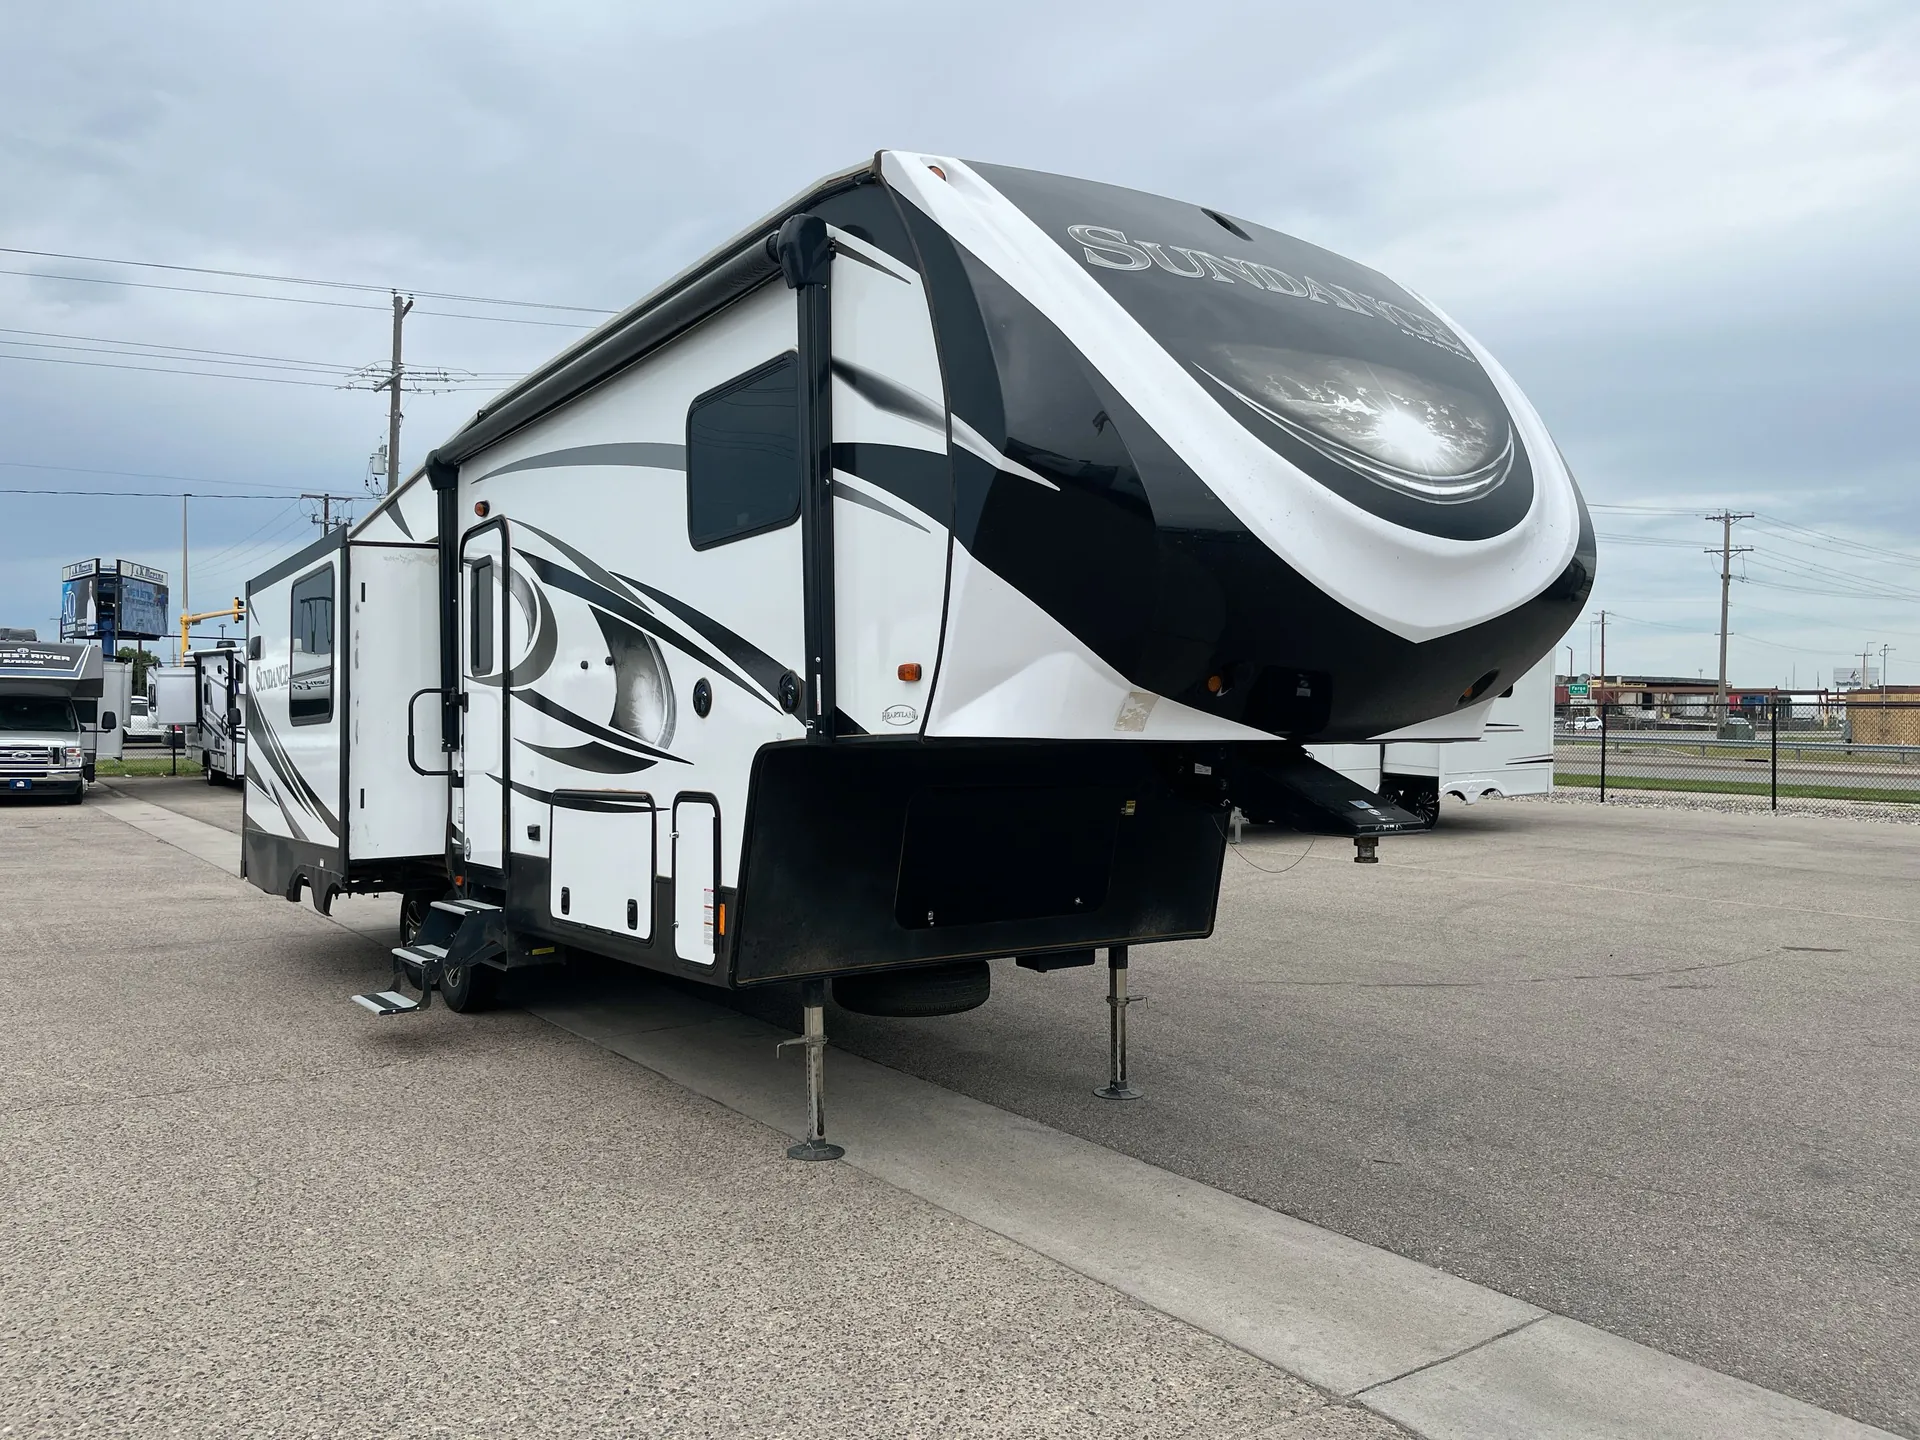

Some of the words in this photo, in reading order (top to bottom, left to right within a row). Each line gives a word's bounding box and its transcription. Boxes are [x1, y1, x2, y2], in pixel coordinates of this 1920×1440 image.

[1067, 224, 1467, 354] SUNDANCE
[1401, 328, 1414, 337] BY
[1416, 334, 1475, 363] HEARTLAND
[31, 653, 70, 661] RIVER
[256, 664, 288, 692] SUNDANCE
